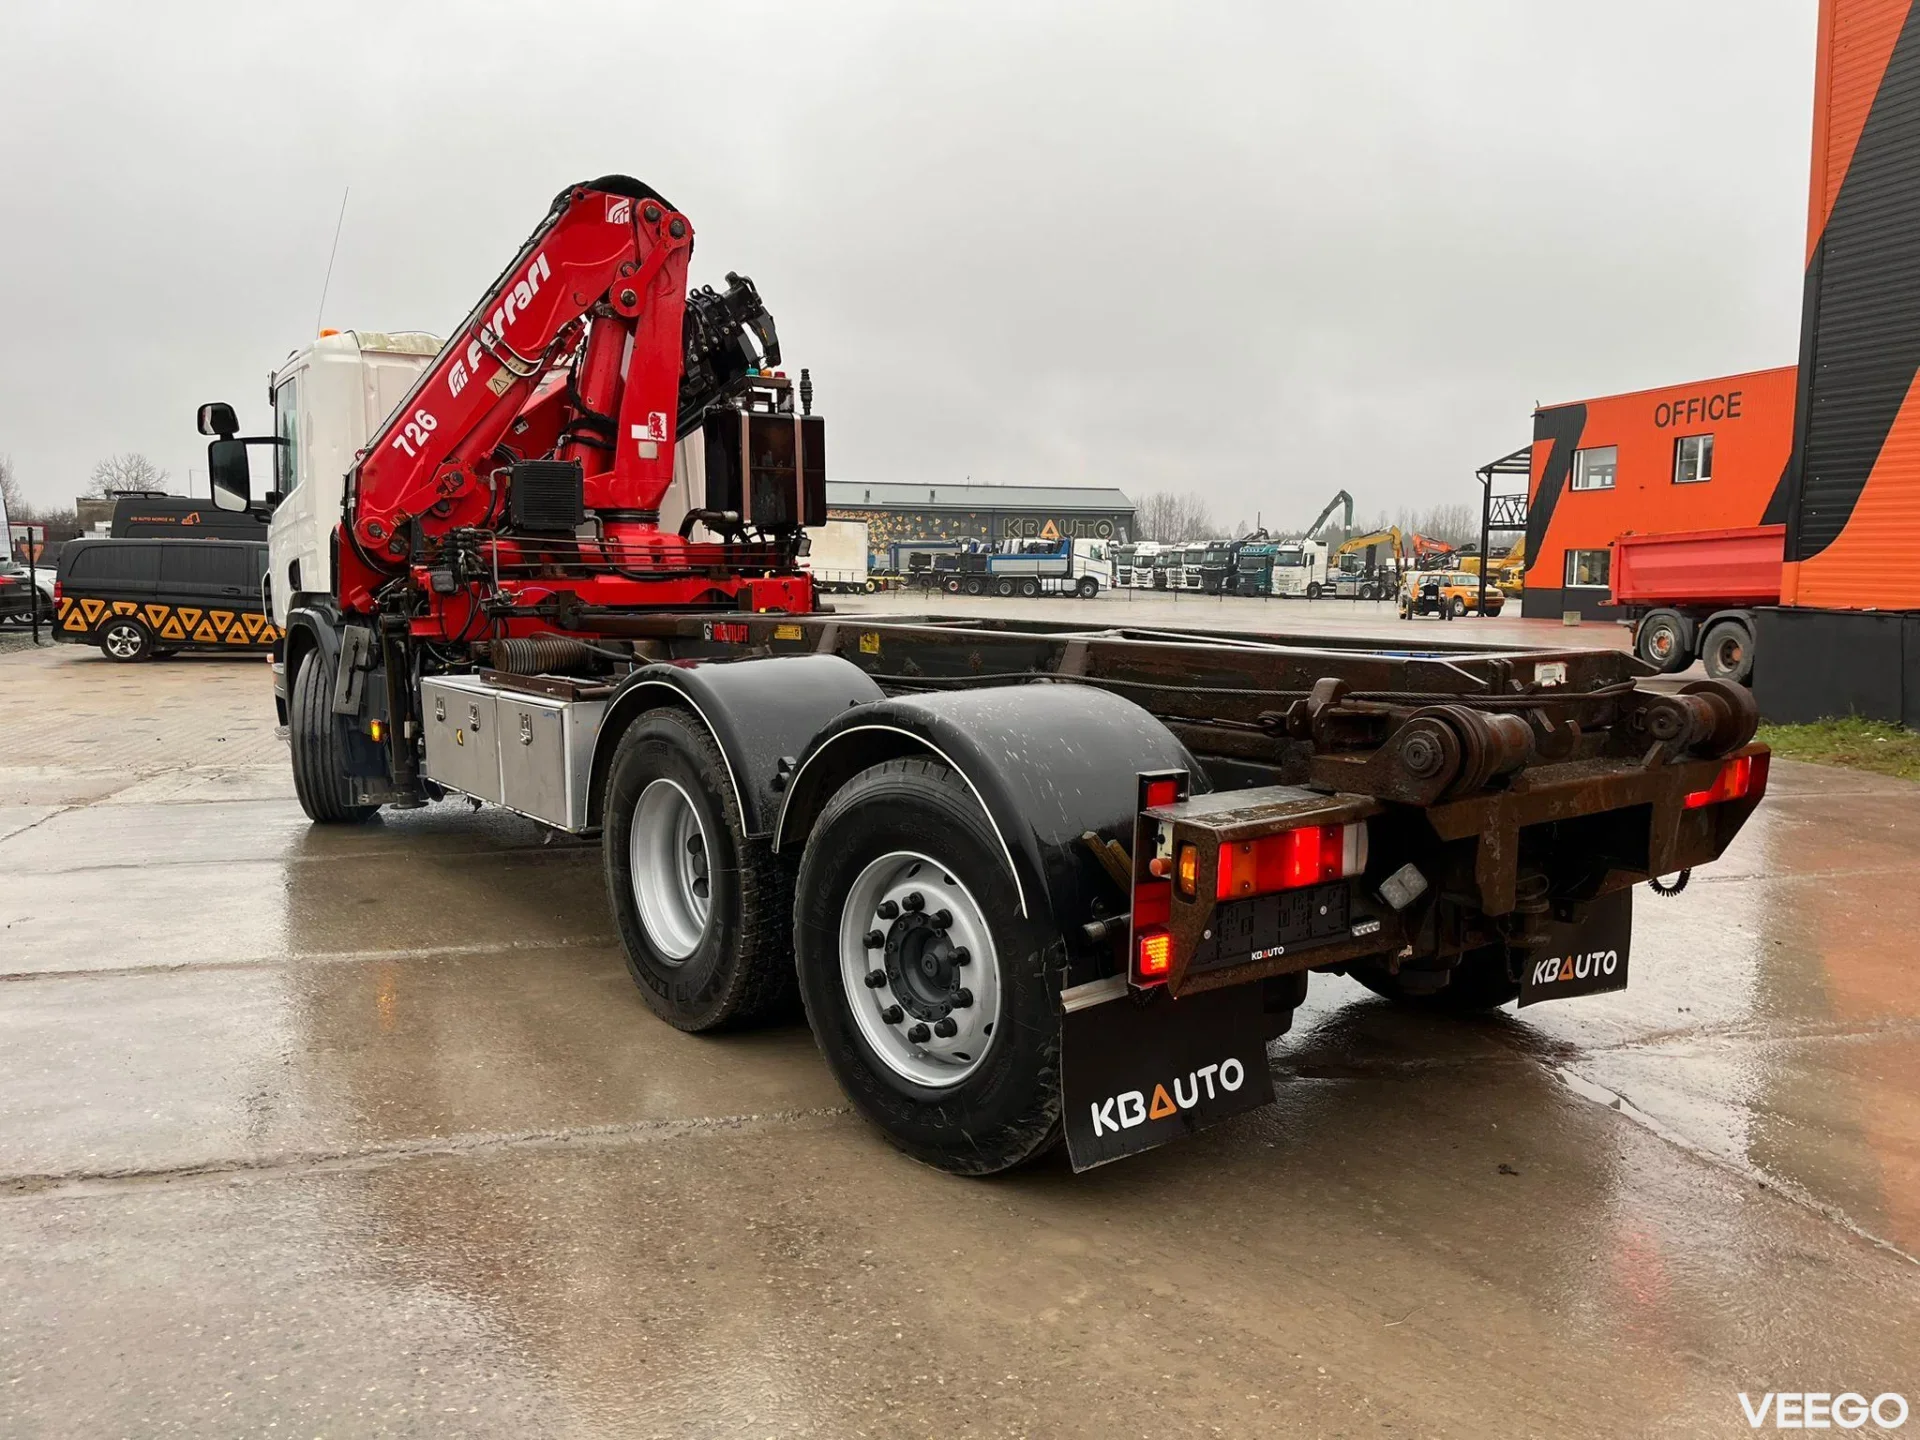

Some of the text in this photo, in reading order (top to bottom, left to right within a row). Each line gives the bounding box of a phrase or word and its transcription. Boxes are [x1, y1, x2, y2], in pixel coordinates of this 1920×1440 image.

[1655, 391, 1742, 428] OFFICE
[391, 408, 438, 458] 726
[1003, 518, 1115, 540] KBAUTO
[1251, 945, 1285, 961] KBAUTO
[1531, 949, 1618, 986] KBAUTO
[1090, 1057, 1245, 1138] KBAUTO
